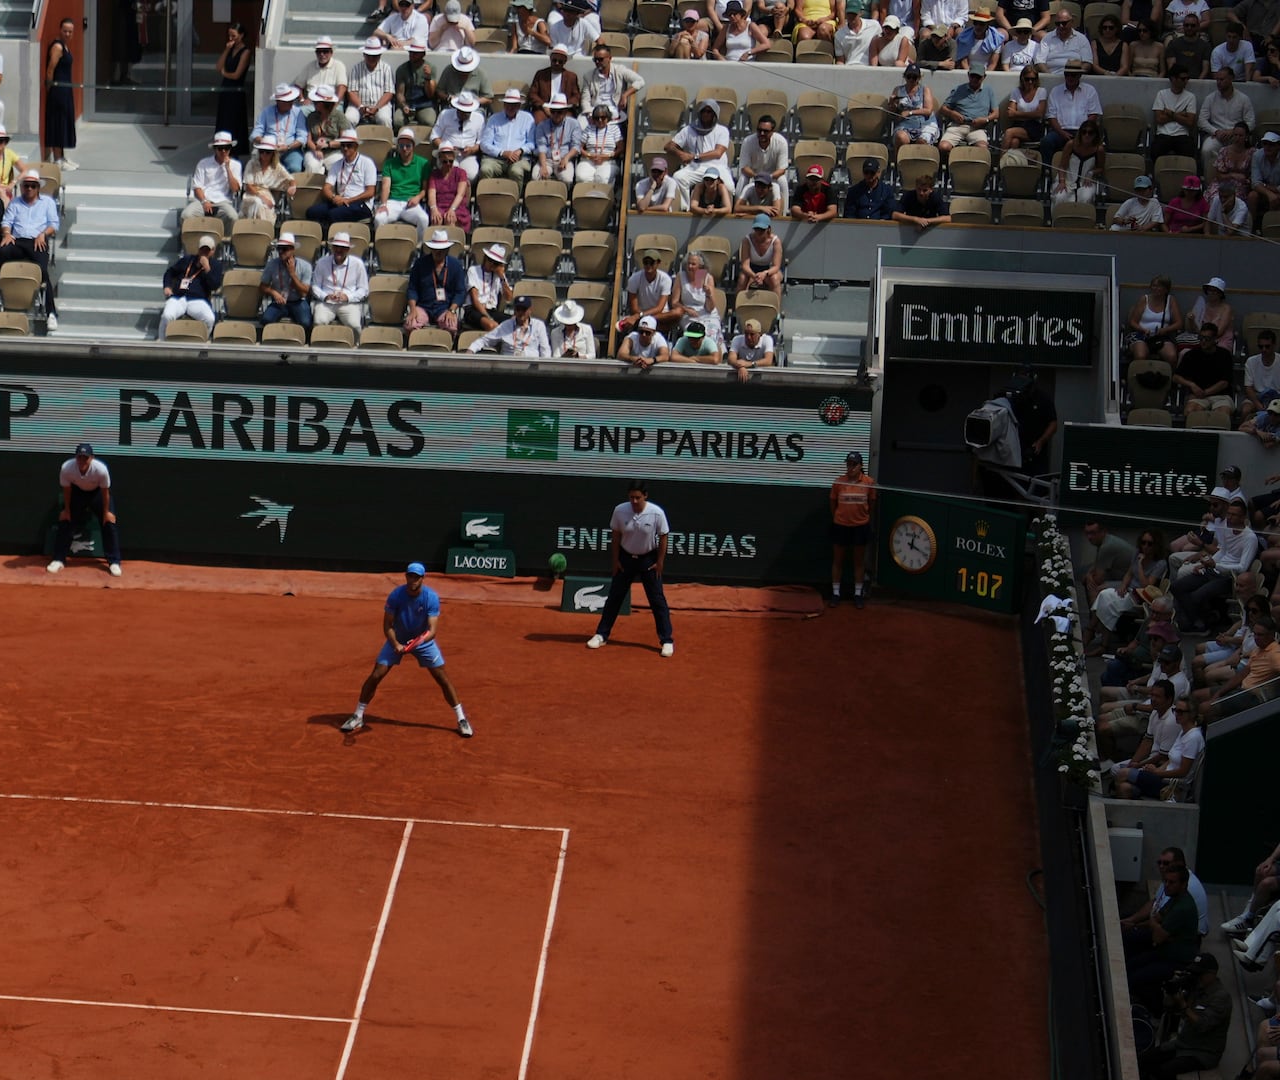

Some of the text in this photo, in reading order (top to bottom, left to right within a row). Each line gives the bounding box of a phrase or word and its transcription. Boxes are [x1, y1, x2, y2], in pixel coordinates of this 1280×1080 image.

[900, 301, 1084, 350] Emirates
[119, 388, 426, 458] PARIBAS
[573, 422, 806, 464] BNP PARIBAS
[1069, 461, 1208, 500] Emirates
[557, 526, 757, 559] BNP RIBAS
[956, 536, 1006, 560] ROLEX
[454, 555, 507, 570] LACOSTE
[958, 567, 1003, 599] 1:07
